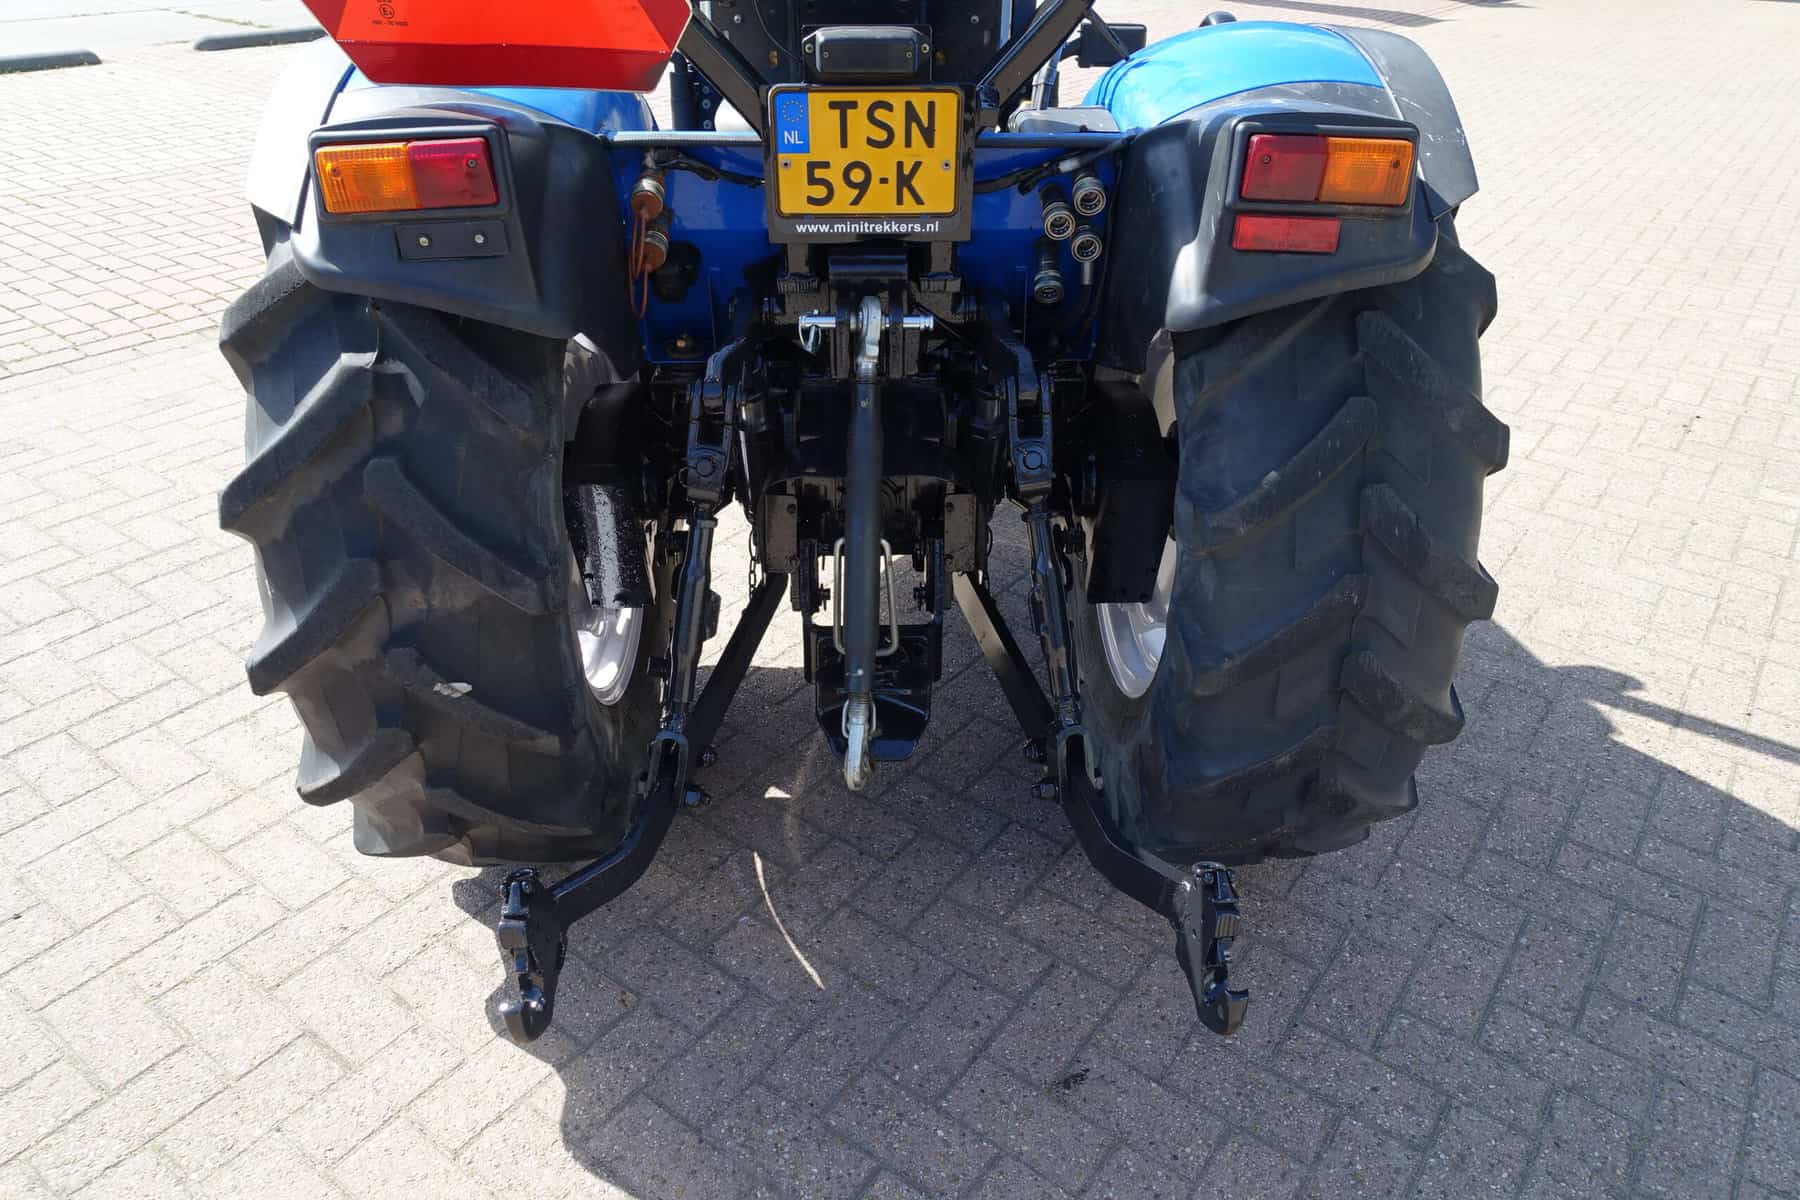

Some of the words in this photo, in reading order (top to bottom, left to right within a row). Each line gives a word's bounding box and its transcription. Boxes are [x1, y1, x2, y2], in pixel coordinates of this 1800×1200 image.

[784, 131, 804, 145] NL
[829, 100, 936, 149] TSN
[805, 160, 926, 206] 59-K
[796, 221, 939, 233] www.minitrekkers.nl
